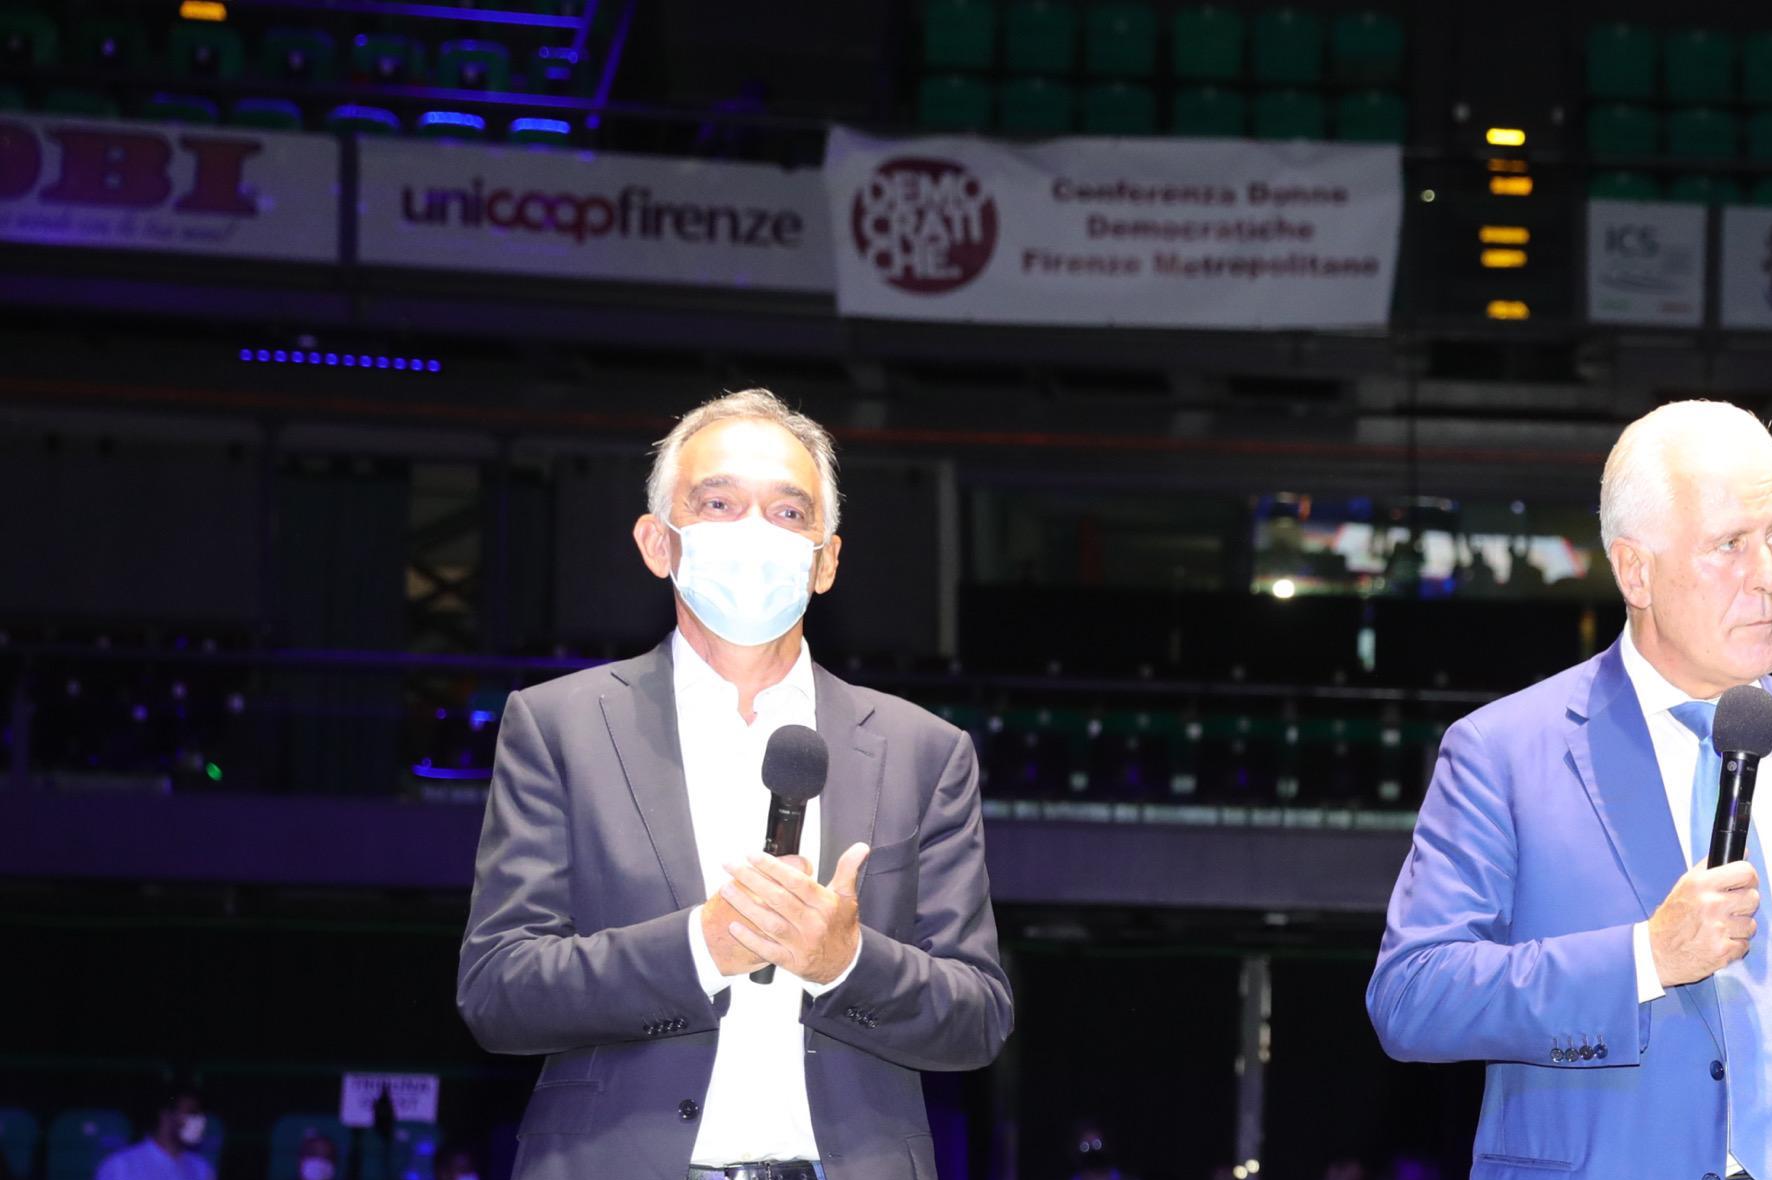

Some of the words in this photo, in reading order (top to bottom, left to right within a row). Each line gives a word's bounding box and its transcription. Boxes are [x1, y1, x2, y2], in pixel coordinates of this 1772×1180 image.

[868, 164, 986, 205] DEMO
[1051, 177, 1236, 205] Conferenza
[402, 178, 804, 248] unicoopfirenze
[866, 204, 983, 244] CRATI
[1086, 213, 1314, 241] Democratiche
[867, 242, 963, 283] CHE
[1021, 249, 1142, 275] Firenze
